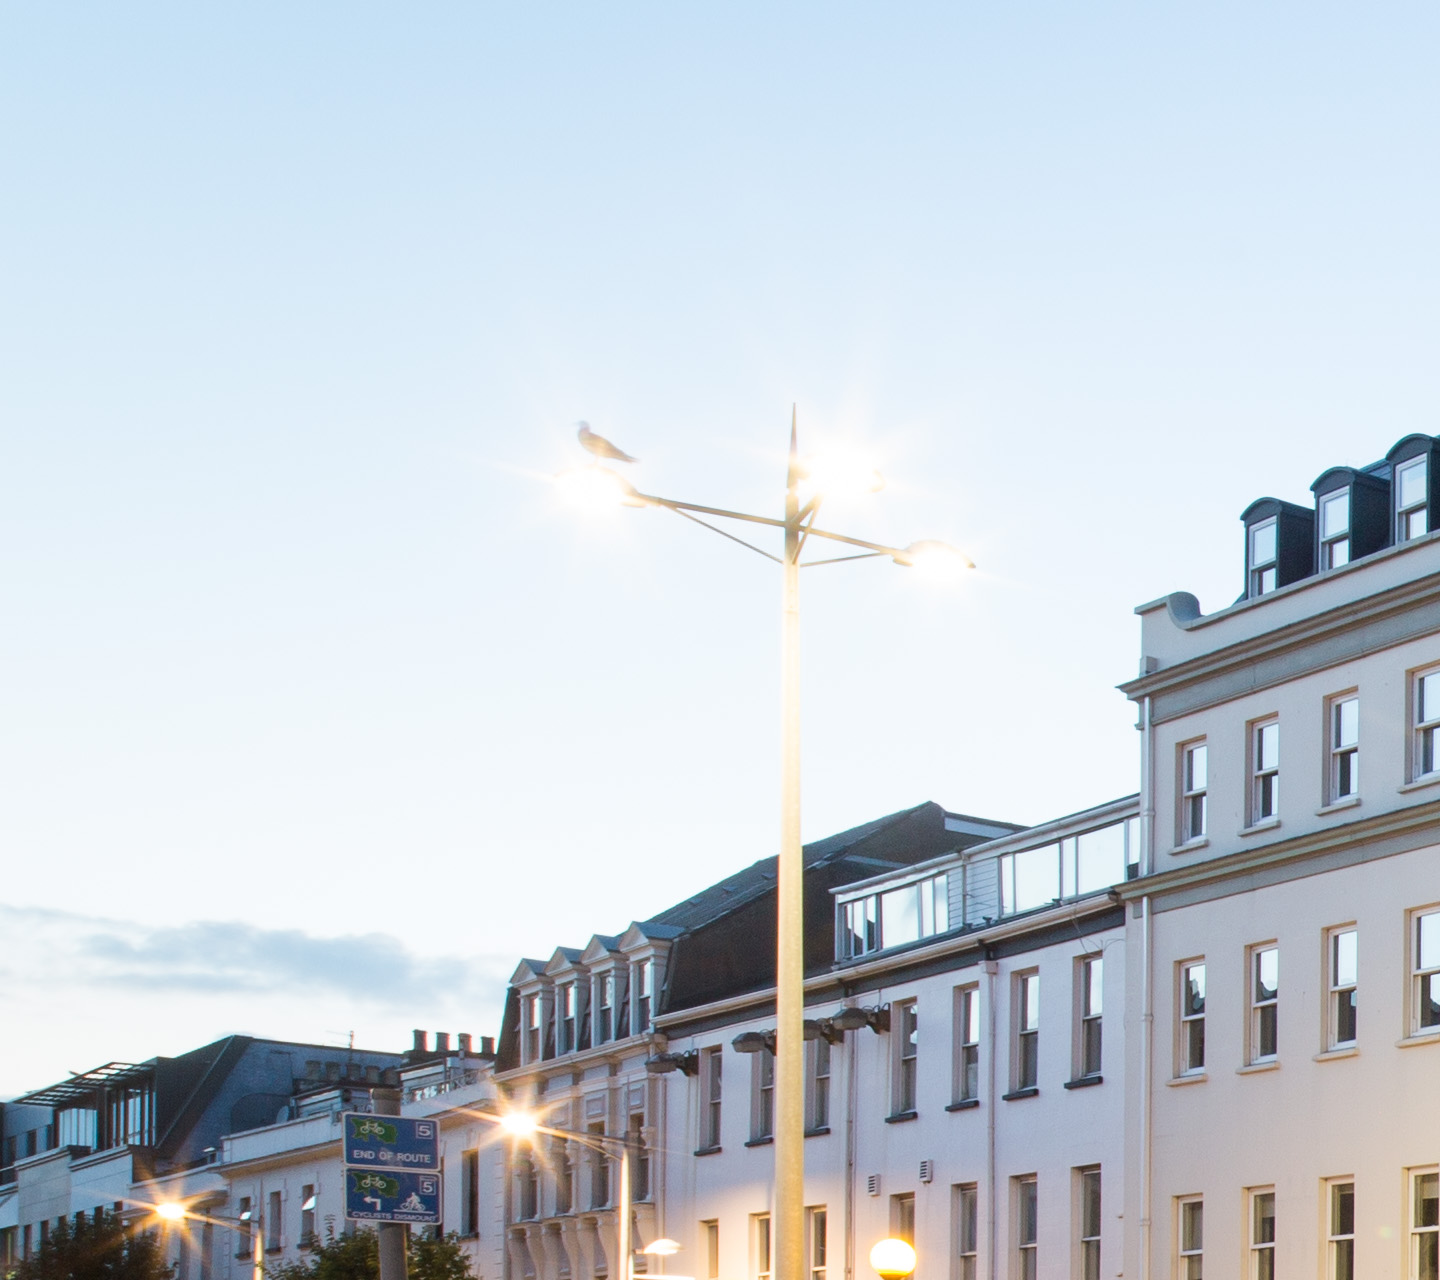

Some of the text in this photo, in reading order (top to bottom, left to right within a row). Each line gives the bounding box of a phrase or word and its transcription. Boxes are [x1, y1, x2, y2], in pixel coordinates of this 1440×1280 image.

[419, 1125, 431, 1136] 5
[353, 1149, 431, 1163] END OF ROUTE
[422, 1181, 433, 1193] 5
[351, 1211, 437, 1222] CYCLISTS DISMOUNT
